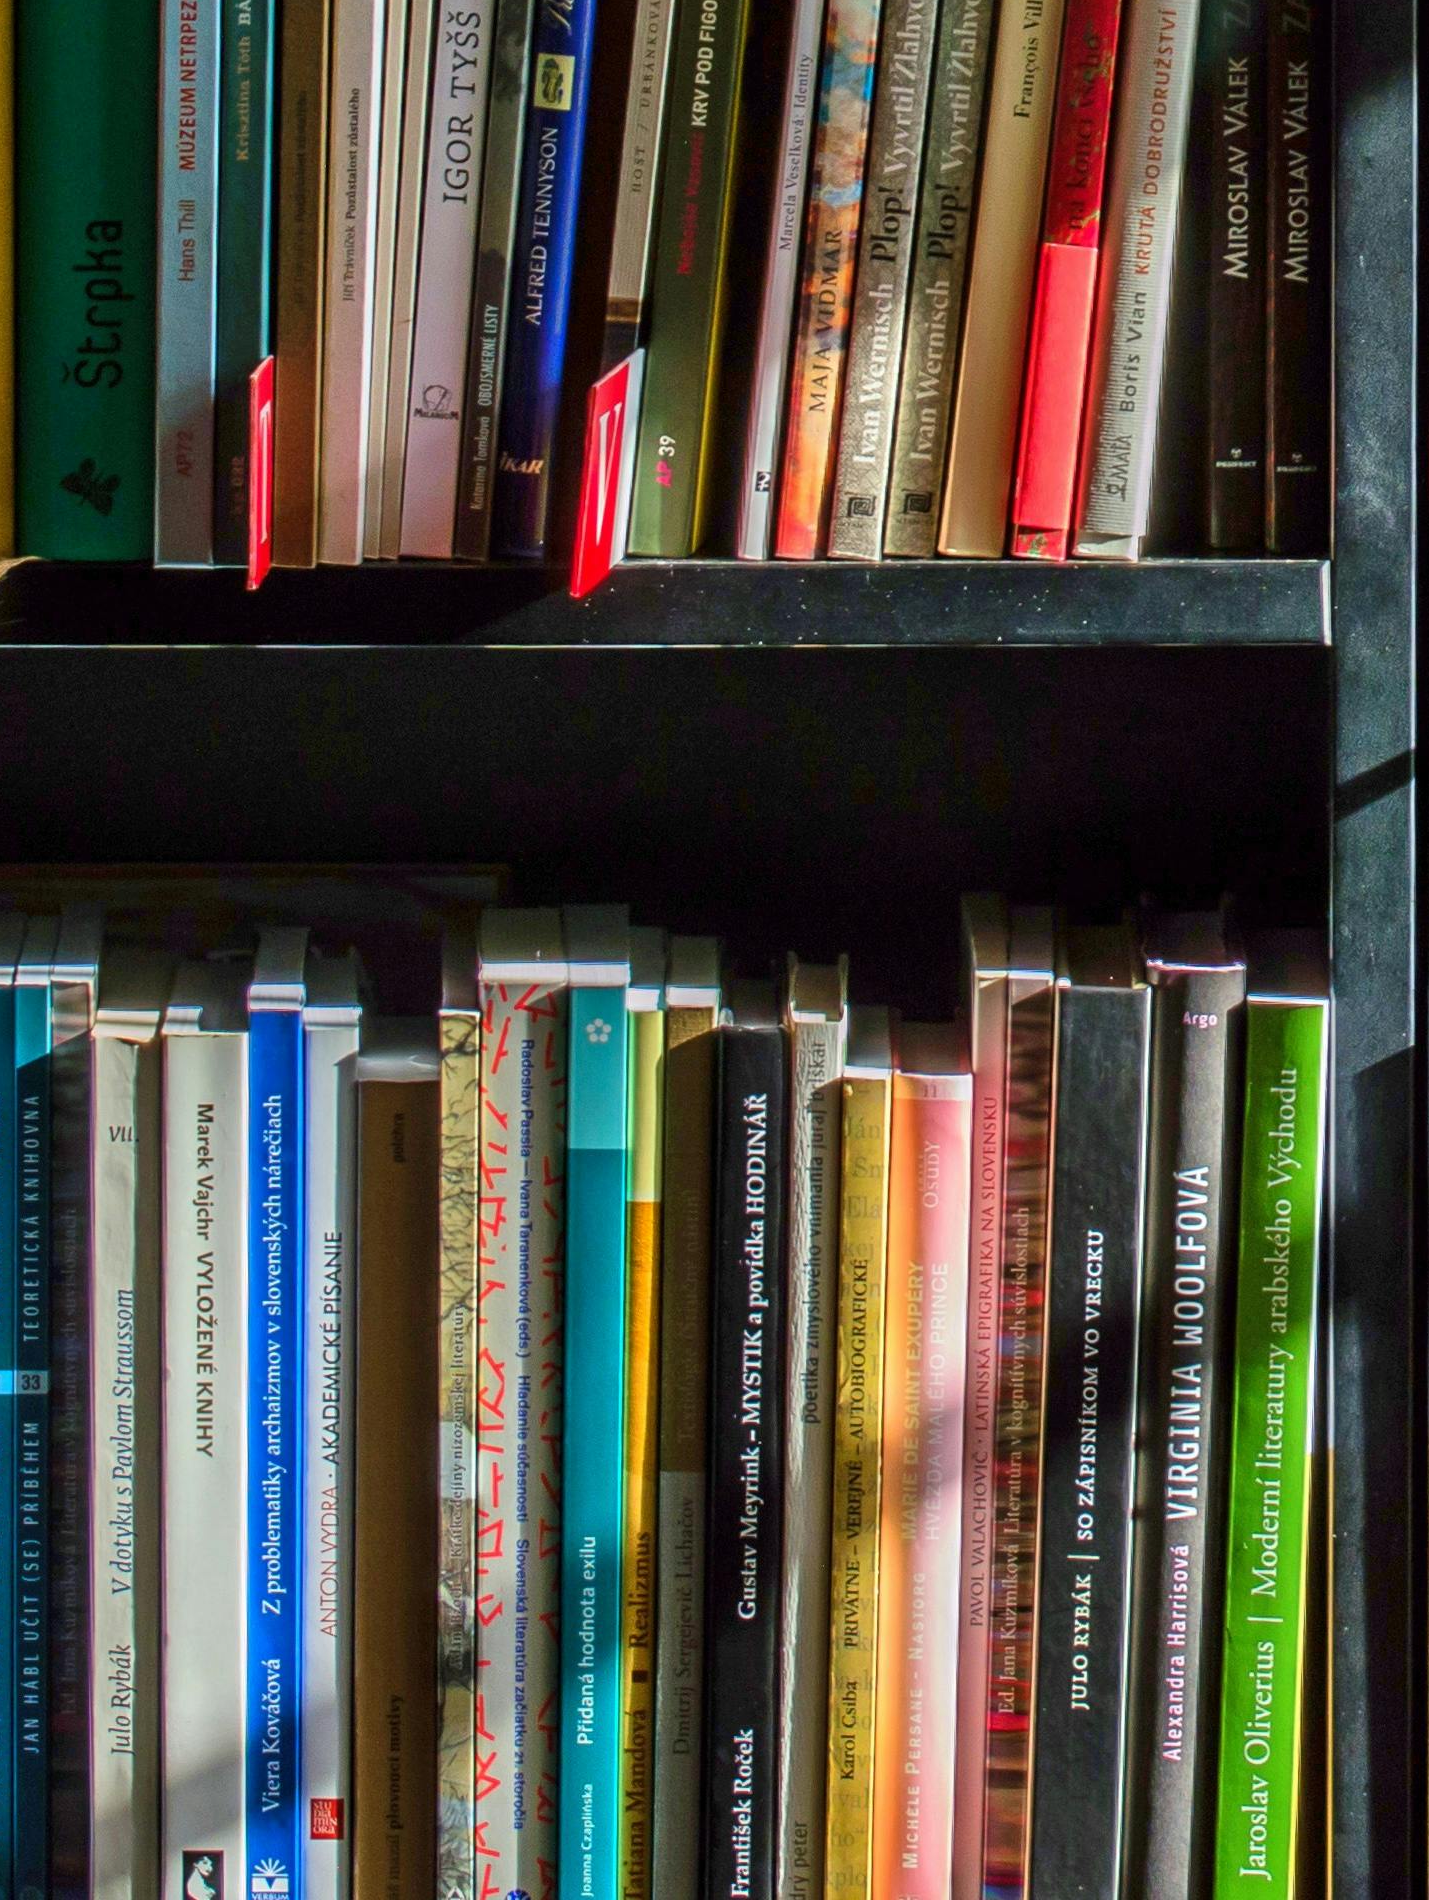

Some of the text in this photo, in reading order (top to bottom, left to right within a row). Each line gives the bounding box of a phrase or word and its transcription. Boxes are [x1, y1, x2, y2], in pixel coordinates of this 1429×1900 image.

[439, 9, 483, 99] TYŠŠ
[1010, 35, 1043, 119] François
[1133, 8, 1176, 196] DOBRODRUŽSTVÍ
[440, 112, 477, 204] IGOR
[523, 126, 560, 325] ALFRED TENNYSON
[1125, 289, 1147, 344] Vian
[1120, 351, 1145, 412] Boris
[1164, 1165, 1211, 1519] VIRGINIA WOOLFOVÁ
[1240, 1067, 1301, 1880] Jaroslav Oliverius Moderní literatury arabského Východu
[259, 1658, 284, 1811] Viera Kováčová
